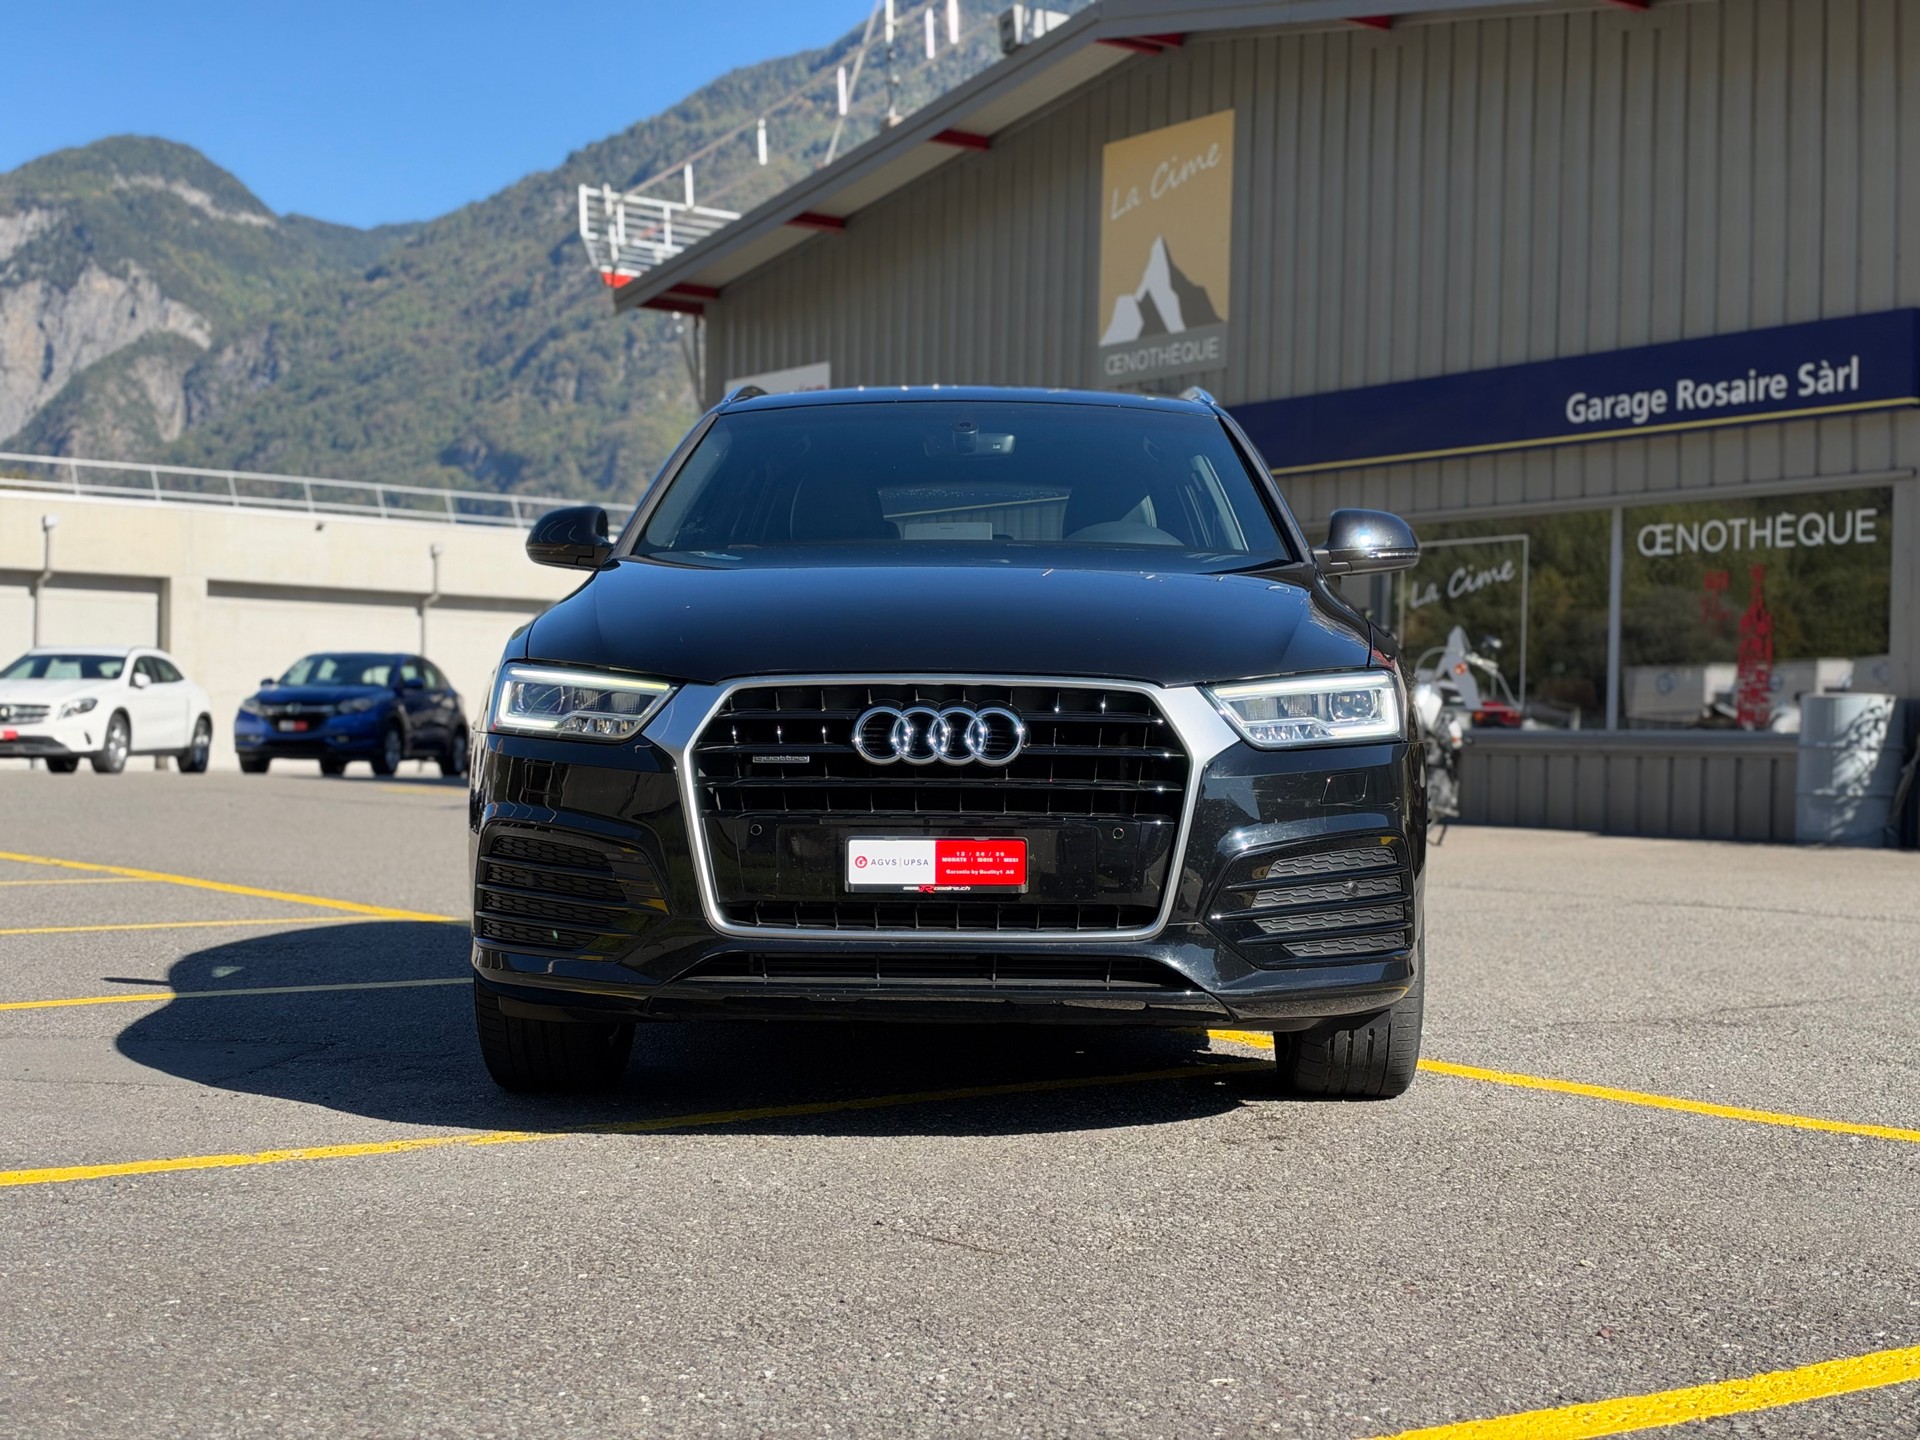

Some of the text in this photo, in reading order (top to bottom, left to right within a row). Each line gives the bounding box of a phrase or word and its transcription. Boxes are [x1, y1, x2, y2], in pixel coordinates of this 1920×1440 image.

[1110, 142, 1222, 221] La Cime
[1566, 355, 1859, 424] Garage Rosaire Sàrl
[1409, 560, 1516, 609] La Cime
[870, 858, 929, 866] AGVS UPSA
